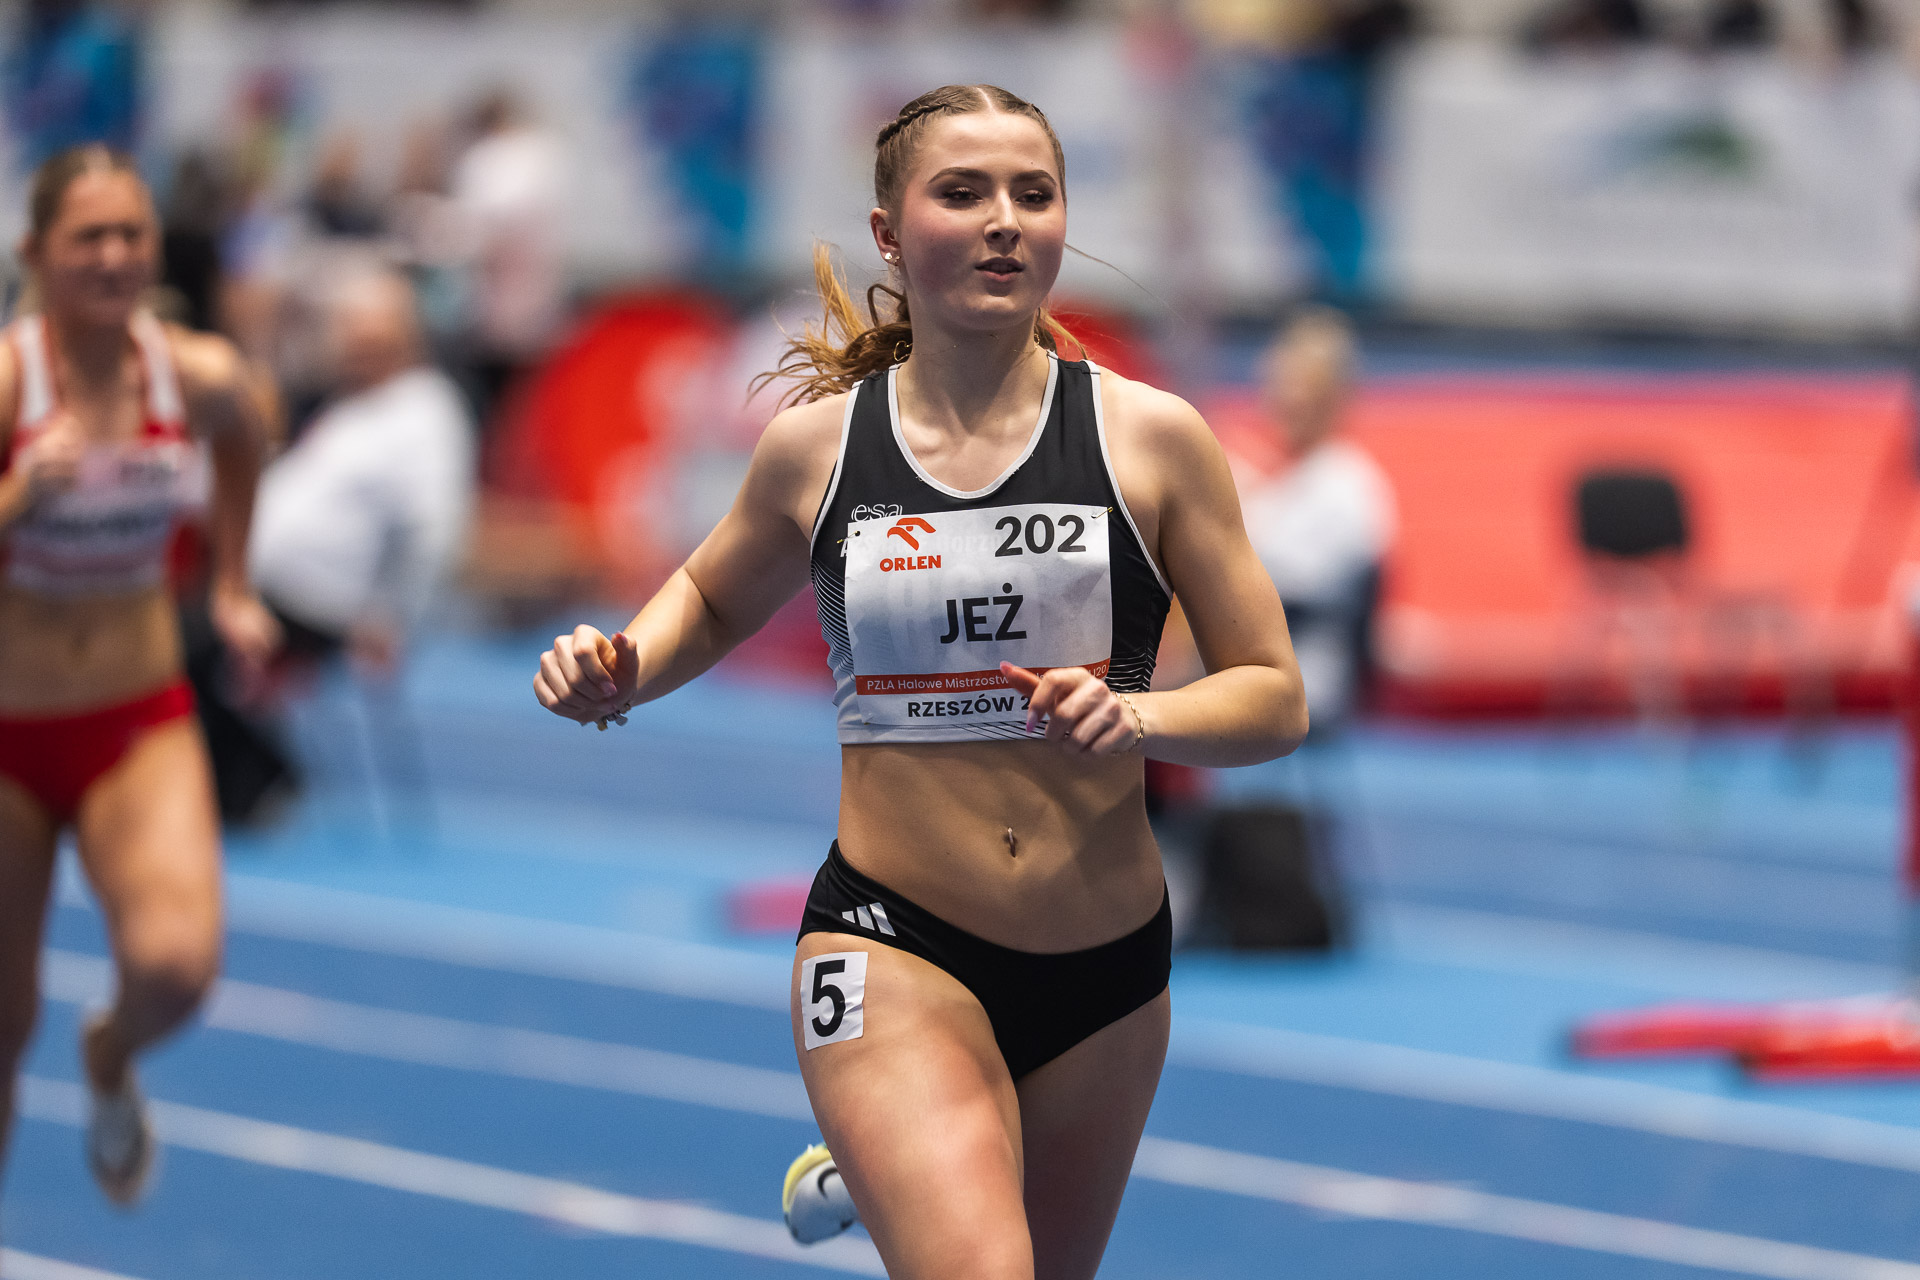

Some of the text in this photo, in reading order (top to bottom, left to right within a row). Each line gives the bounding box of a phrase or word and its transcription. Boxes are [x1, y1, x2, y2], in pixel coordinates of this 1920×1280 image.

[994, 513, 1087, 557] 202
[879, 555, 942, 572] ORLEN
[940, 582, 1027, 644] JEŻ
[867, 680, 895, 690] PZLA
[898, 678, 943, 690] Halowe
[945, 674, 1009, 689] Mistrzostw
[908, 693, 1015, 718] RZESZÓW
[811, 958, 846, 1037] 5
